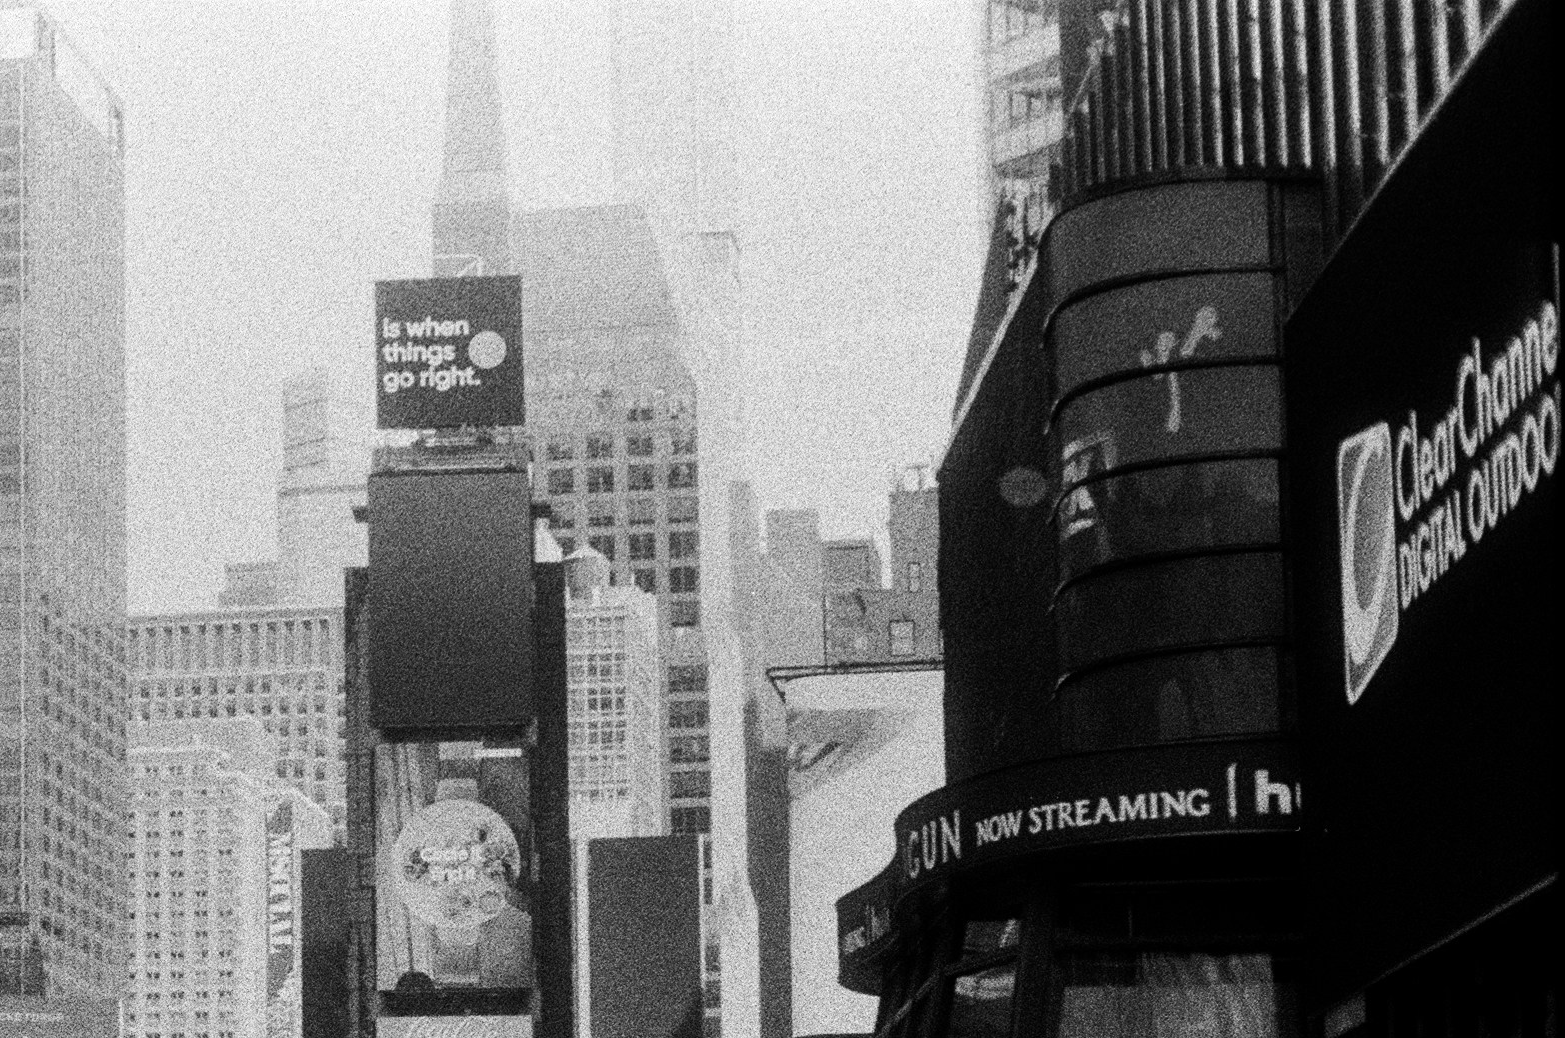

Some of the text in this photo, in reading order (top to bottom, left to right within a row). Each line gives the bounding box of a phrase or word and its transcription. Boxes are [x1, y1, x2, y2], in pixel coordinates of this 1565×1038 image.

[382, 314, 470, 339] is when
[382, 341, 456, 367] things
[383, 365, 482, 394] go right.
[1400, 379, 1563, 609] DIGITAL OUTDOO
[902, 786, 1212, 881] GUN NOW STREAMING
